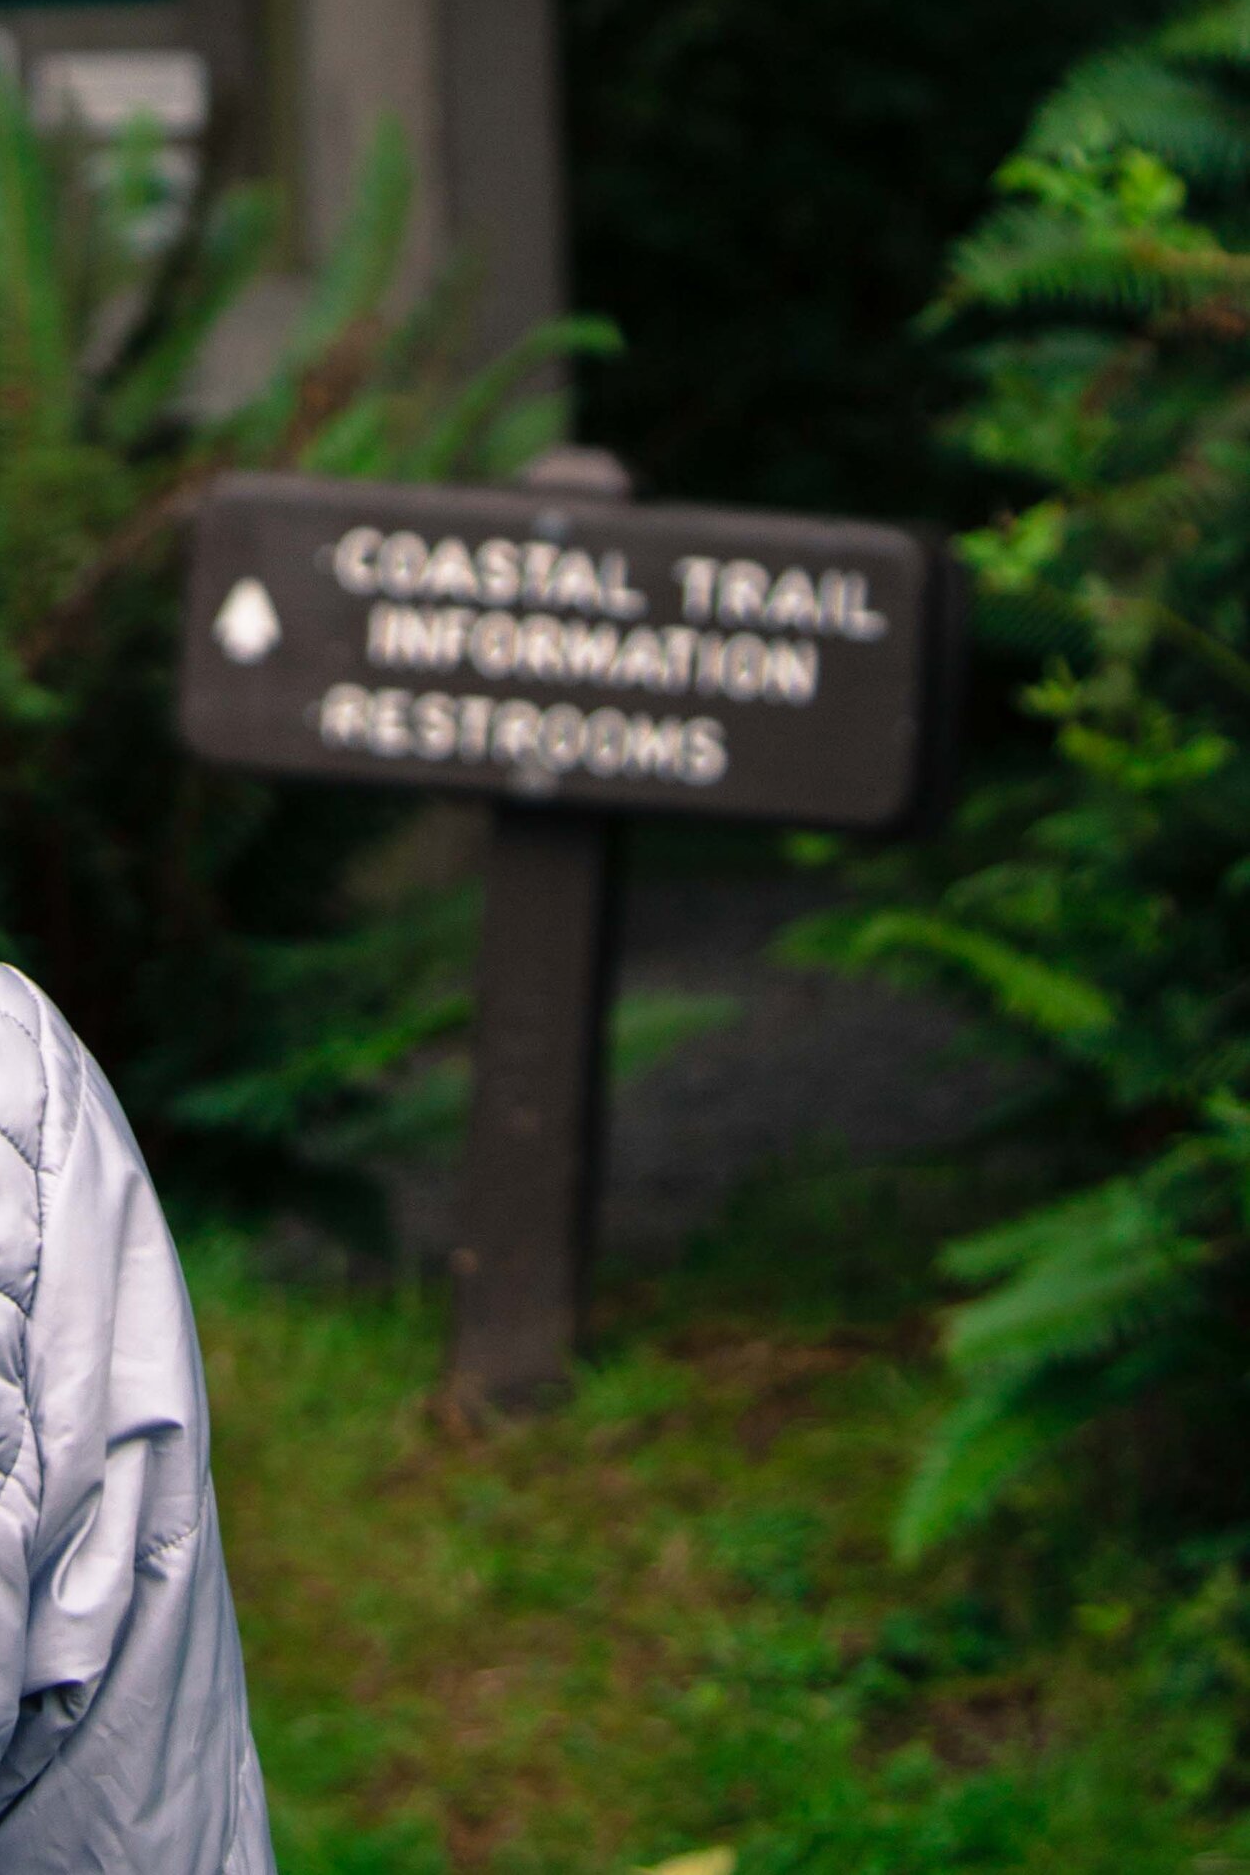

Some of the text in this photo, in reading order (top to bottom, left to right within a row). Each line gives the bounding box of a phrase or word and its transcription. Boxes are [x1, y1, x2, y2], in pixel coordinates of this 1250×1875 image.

[336, 527, 886, 640] COASTAL TRAIL
[368, 603, 818, 704] INFORMATION
[321, 683, 728, 785] RESTROOMS
